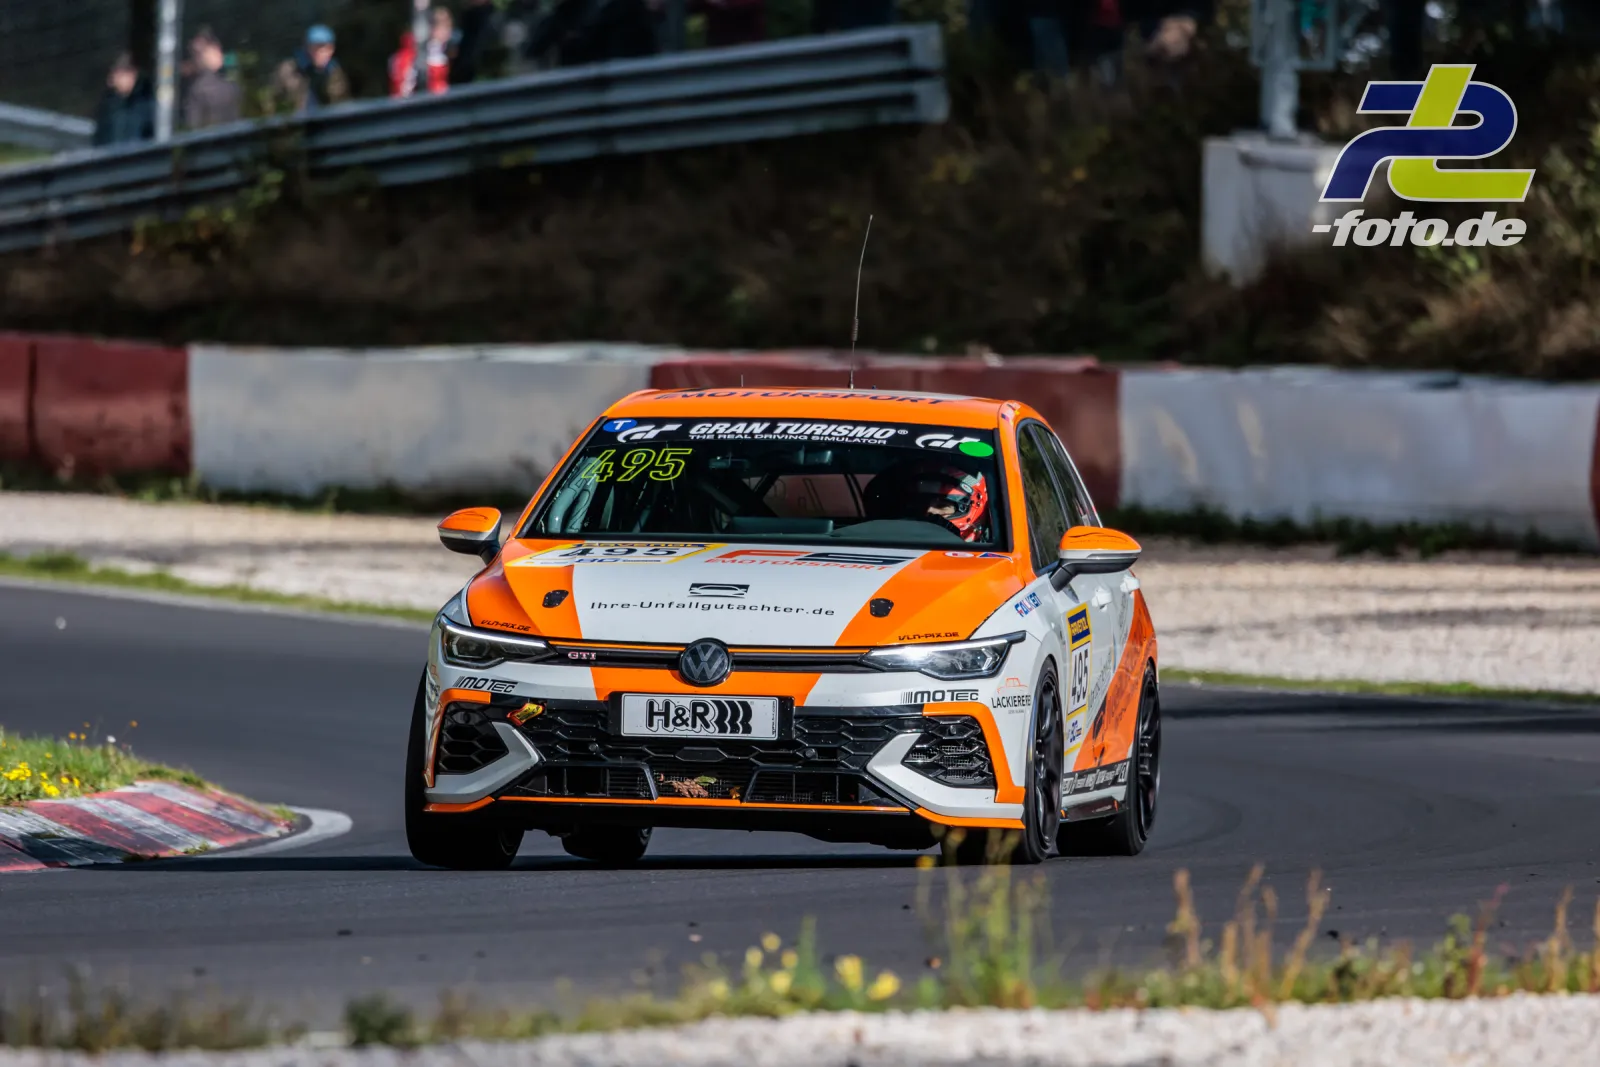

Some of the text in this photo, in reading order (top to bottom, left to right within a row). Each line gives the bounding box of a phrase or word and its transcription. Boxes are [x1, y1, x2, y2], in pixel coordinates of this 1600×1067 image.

[689, 422, 772, 435] GRAN
[811, 436, 887, 445] SIMULATOR
[581, 448, 693, 483] 495
[559, 546, 681, 557] 495
[704, 557, 893, 572] EMOTORSPORT
[590, 601, 835, 616] Ihre-Unfallgutachter.de
[567, 651, 597, 661] GTI
[1071, 648, 1089, 706] 495
[913, 689, 979, 703] MOTEC
[646, 698, 717, 734] H&R
